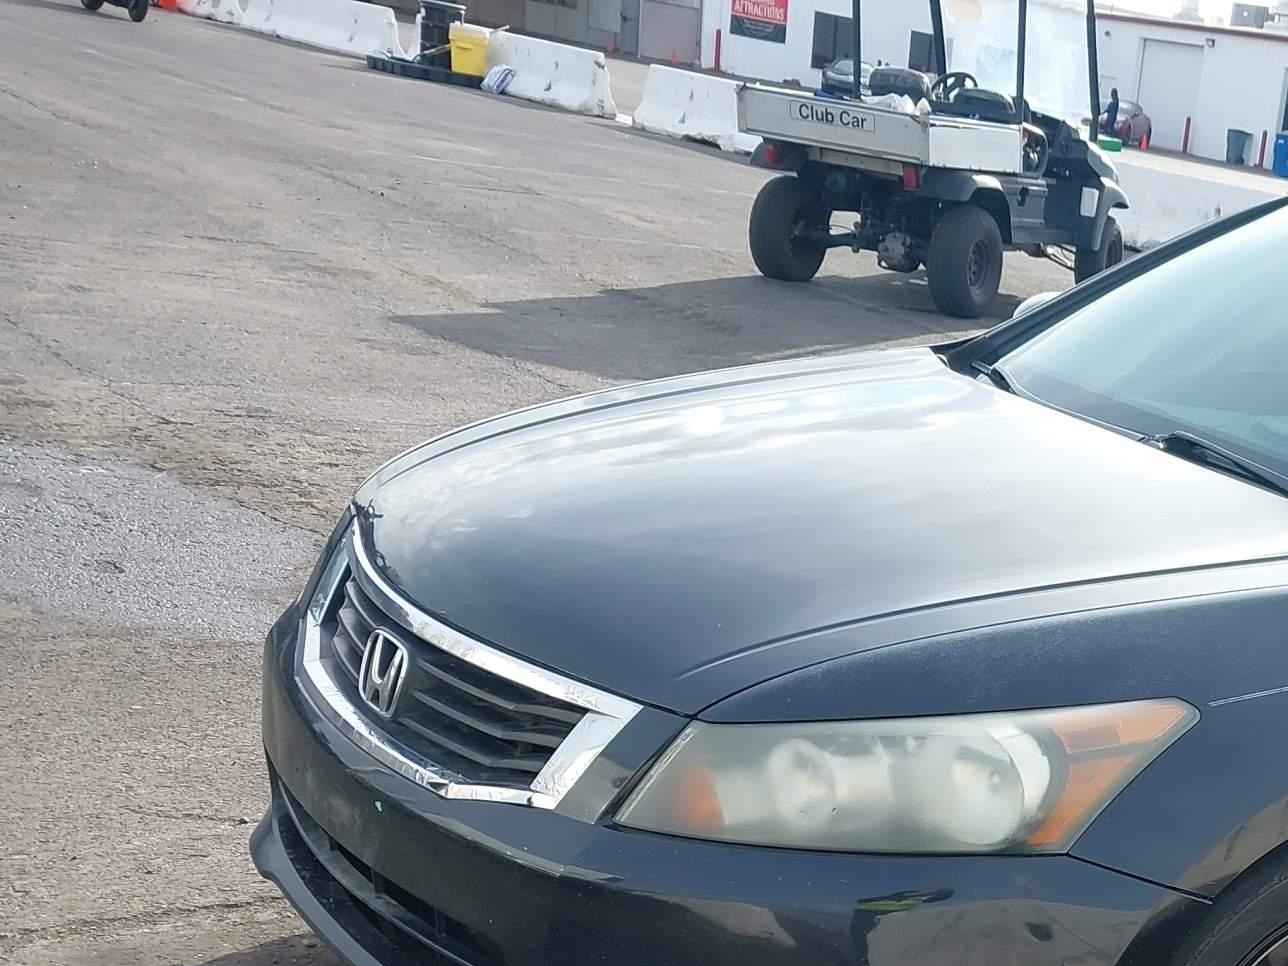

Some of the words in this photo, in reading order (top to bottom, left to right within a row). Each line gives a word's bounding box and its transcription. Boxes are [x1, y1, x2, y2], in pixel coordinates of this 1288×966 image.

[734, 0, 785, 20] ATTRACTIONS
[799, 104, 834, 123] Club
[840, 110, 867, 128] Car
